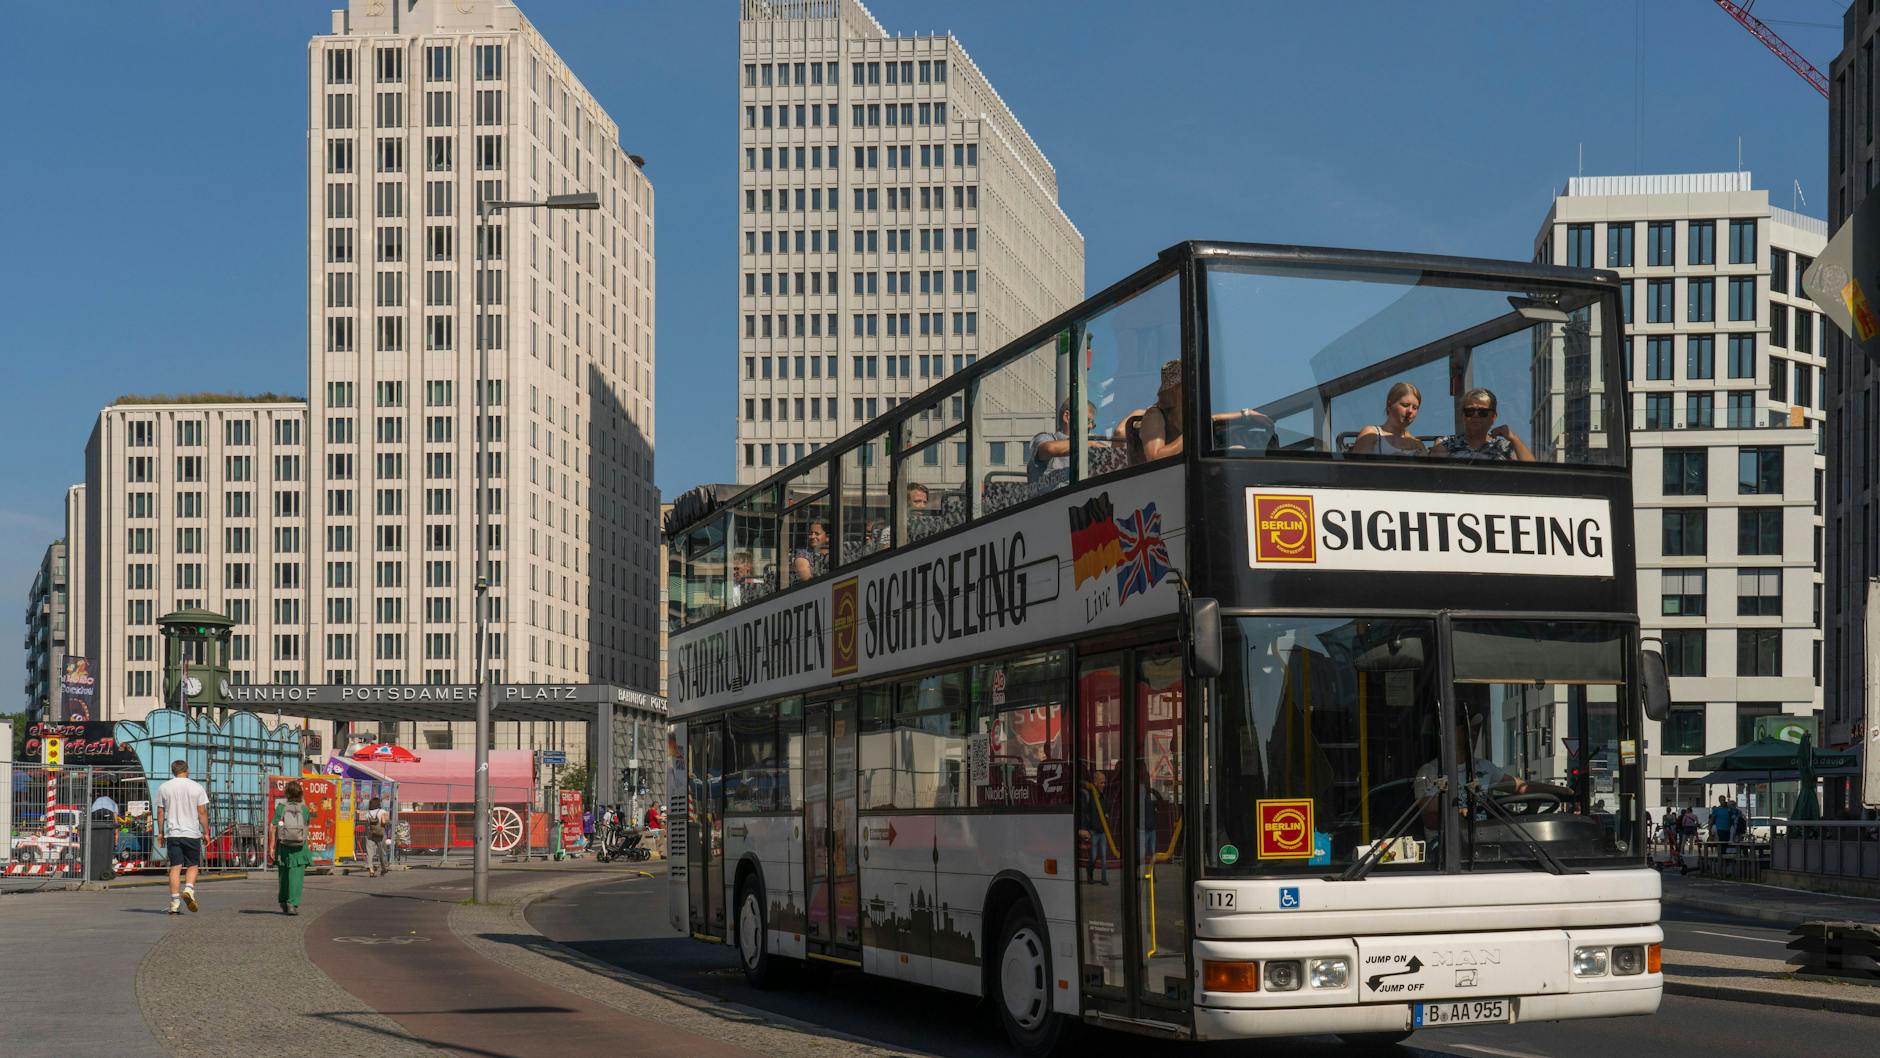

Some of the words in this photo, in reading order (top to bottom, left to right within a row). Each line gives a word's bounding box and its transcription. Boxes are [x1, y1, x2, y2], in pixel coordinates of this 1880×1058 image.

[1261, 520, 1303, 530] BERLIN
[1321, 509, 1603, 557] SIGHTSEEING
[864, 530, 1027, 659] SIGHTSEEING
[1085, 586, 1111, 624] Live
[677, 596, 826, 704] STADTRUNDFAHRTEN
[228, 687, 318, 700] AHNHOF
[342, 687, 477, 700] POTSDAMER
[506, 687, 578, 699] PLATZ
[618, 688, 647, 704] BAHNHOF
[309, 782, 328, 794] DORF
[1265, 822, 1301, 831] BERLIN
[1208, 893, 1234, 906] 112
[1366, 956, 1391, 964] JUMP
[1432, 949, 1501, 966] MAN
[1380, 985, 1405, 993] JUMP
[1429, 1005, 1440, 1022] B
[1450, 1003, 1470, 1021] AA
[1474, 1001, 1502, 1019] 955
